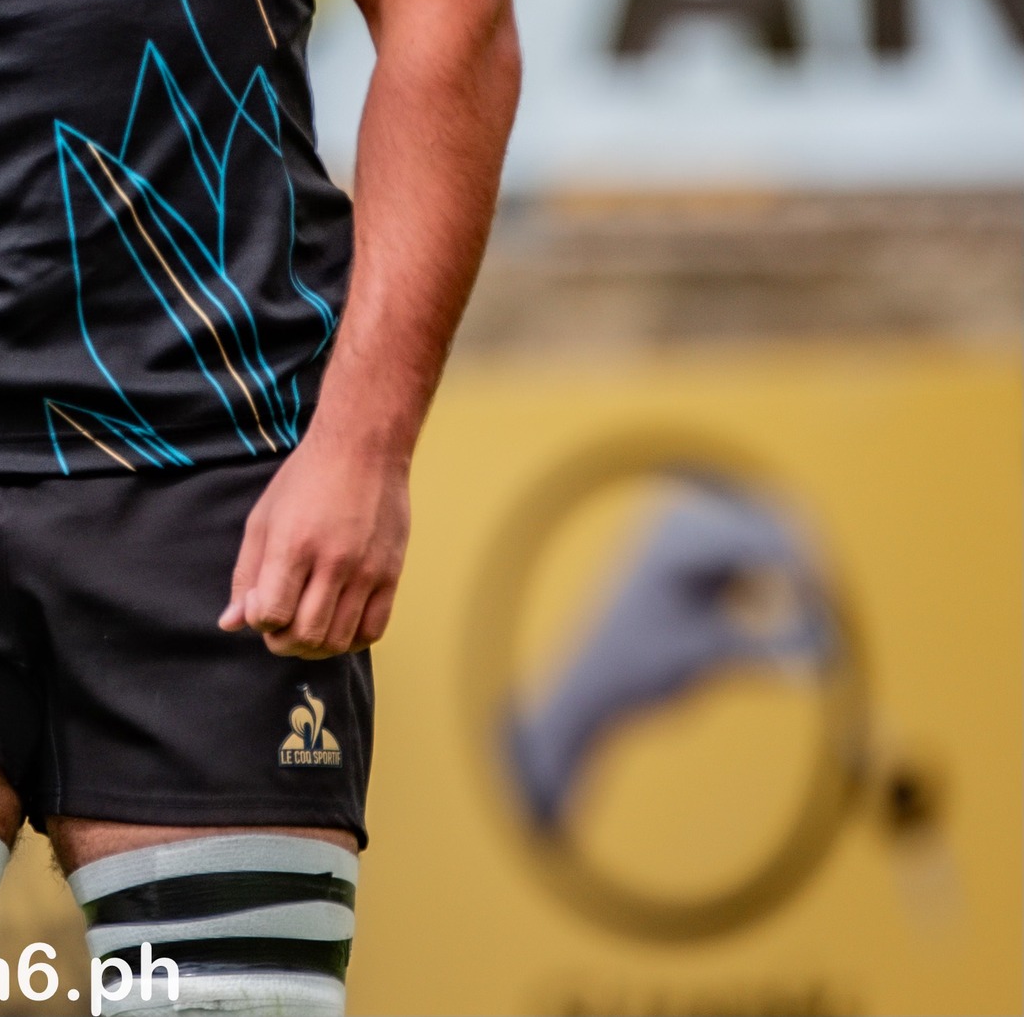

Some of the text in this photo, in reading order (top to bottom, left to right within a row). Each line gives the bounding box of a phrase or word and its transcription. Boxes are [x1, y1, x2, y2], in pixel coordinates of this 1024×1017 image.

[280, 750, 341, 766] LE COQ SPORTIF
